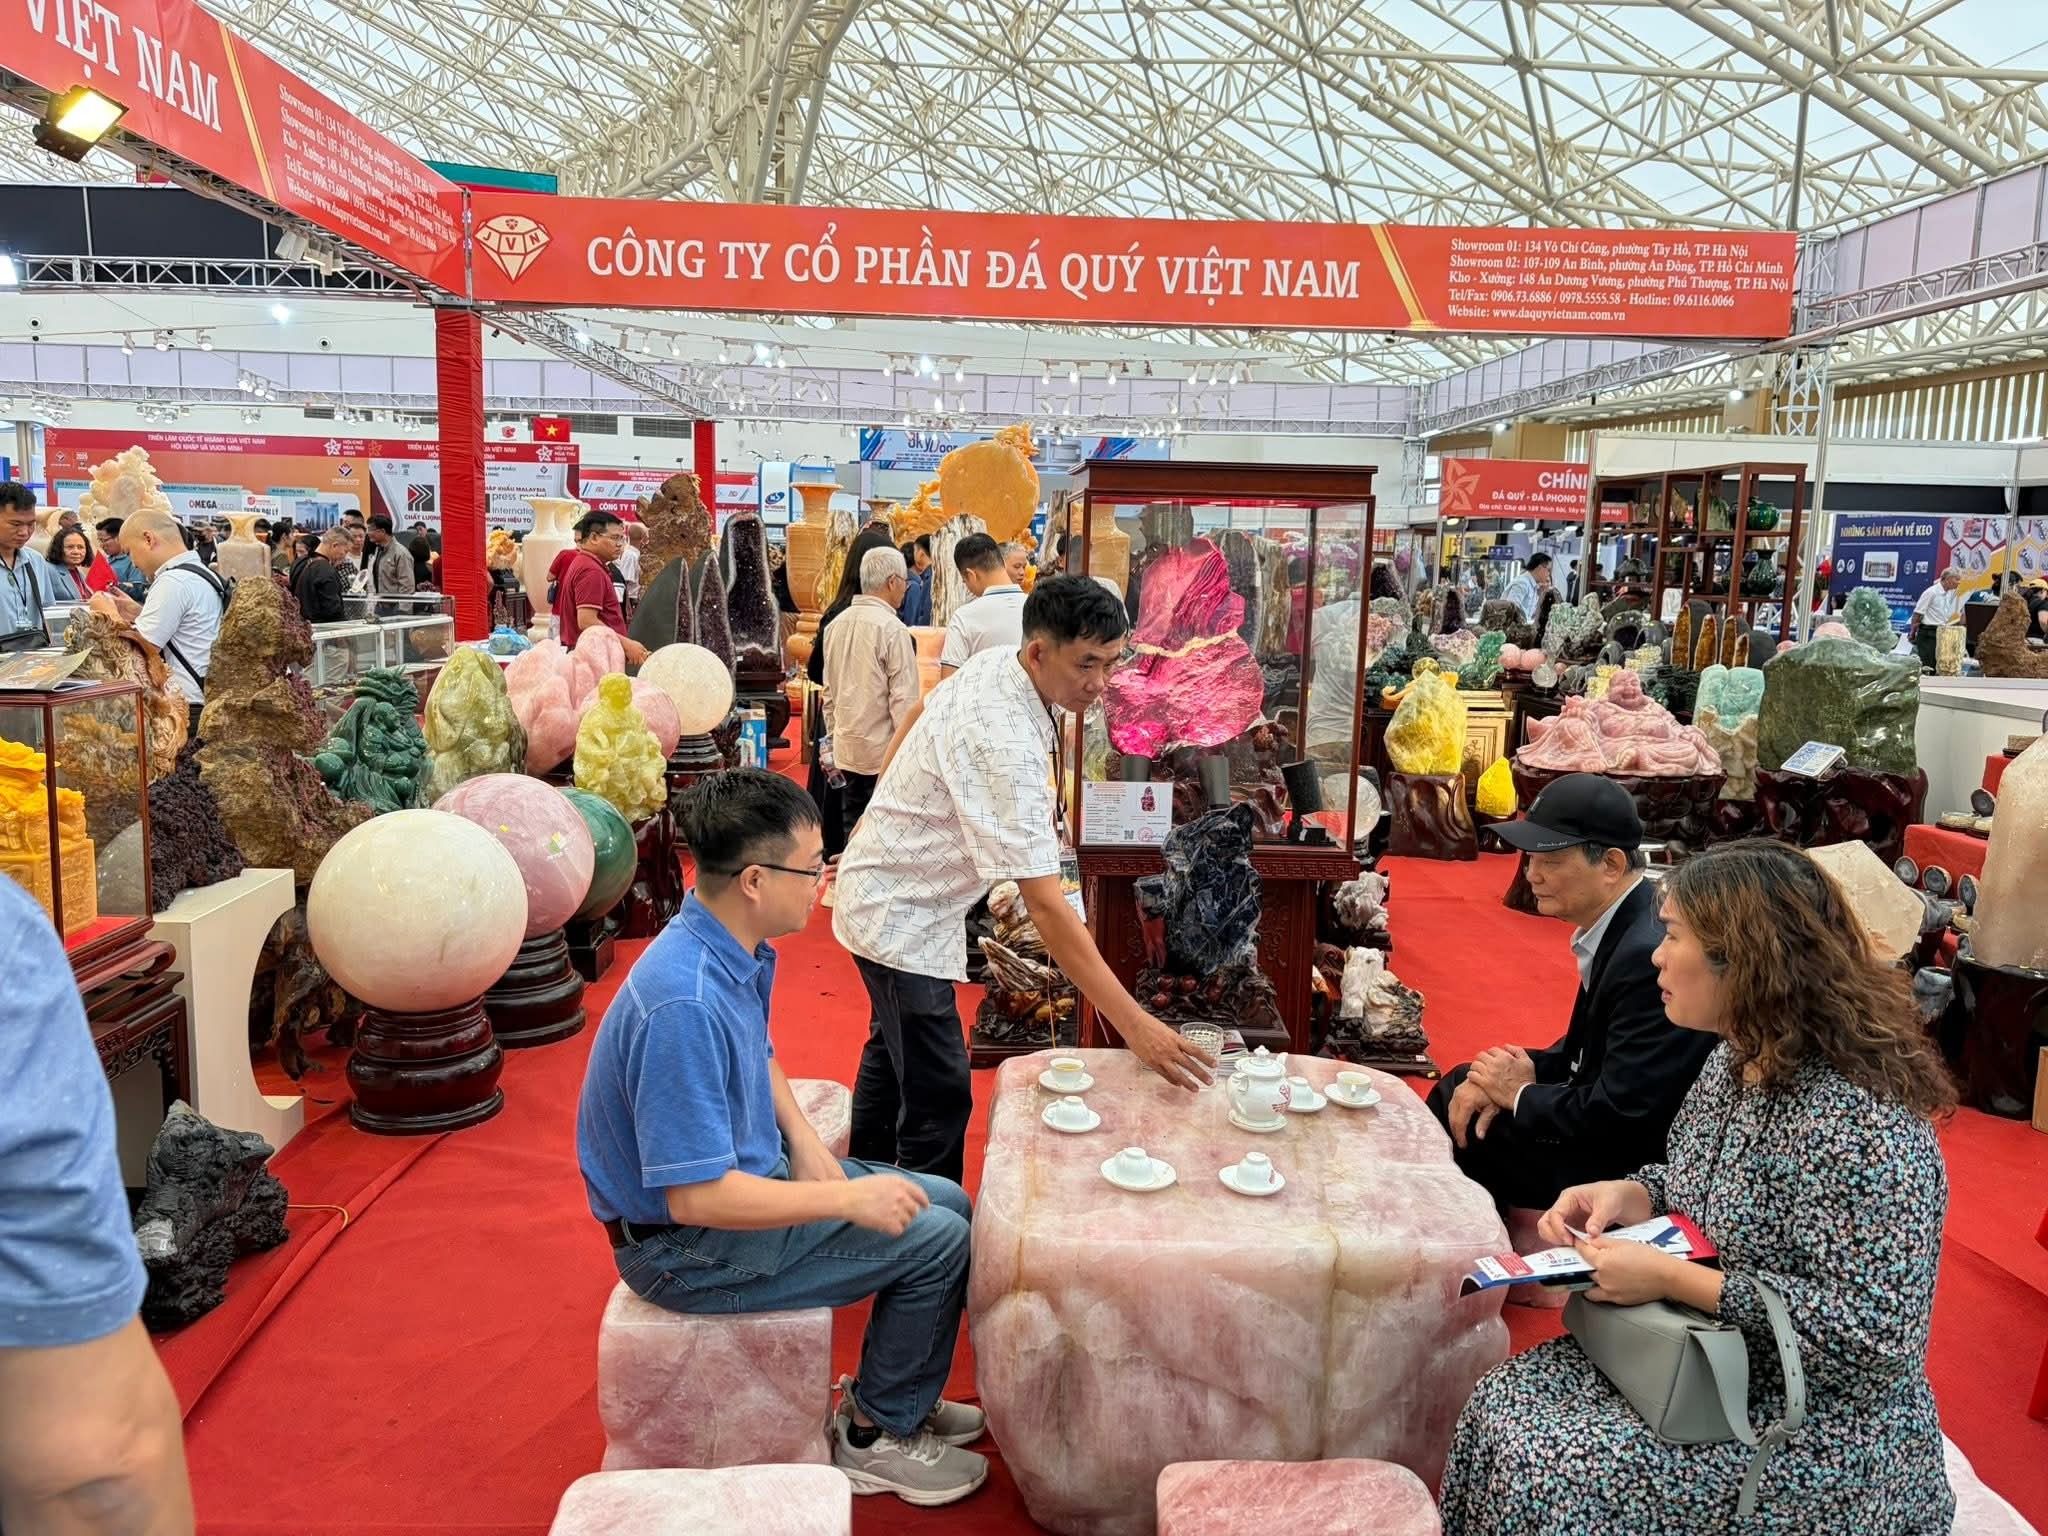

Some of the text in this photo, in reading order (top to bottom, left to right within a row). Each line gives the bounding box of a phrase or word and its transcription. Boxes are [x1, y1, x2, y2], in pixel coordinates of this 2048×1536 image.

[132, 26, 223, 133] NAM
[279, 83, 314, 119] Showroom
[1451, 238, 1505, 252] Showroom
[1506, 240, 1522, 252] 01:
[1525, 240, 1541, 253] 134
[1560, 240, 1578, 254] Chí
[1712, 244, 1728, 257] Hà
[1729, 244, 1749, 259] Nội
[587, 222, 1361, 306] CÔNG TY CỔ PHẦN ĐÁ QUÝ VIỆT NAM
[1450, 254, 1503, 268] Showroom
[1505, 256, 1521, 268] 02:
[1524, 257, 1560, 269] 107-109
[1562, 258, 1577, 269] An
[1648, 260, 1663, 272] An
[1735, 260, 1753, 273] Chí
[1755, 261, 1784, 274] Minh
[1448, 271, 1471, 283] Kho
[1518, 274, 1535, 285] 148
[1537, 274, 1552, 285] An
[1752, 278, 1768, 289] Hà
[1770, 278, 1789, 293] Nội
[1449, 288, 1489, 301] Tel/Fax:
[1490, 290, 1552, 303] 0906.73.6886
[1559, 292, 1621, 305] 0978.5555.58
[1629, 293, 1671, 306] Hotline:
[1673, 294, 1735, 307] 09.6116.0066
[1448, 305, 1626, 321] Website: www.daquyvietnam.com.vn
[1538, 469, 1587, 489] CHÍN
[188, 500, 217, 509] OMEGA
[1491, 490, 1505, 499] ĐÁ
[1506, 490, 1526, 501] QUÝ
[1531, 491, 1544, 502] ĐÁ
[1546, 494, 1576, 504] PHONG
[1915, 524, 1933, 537] KEO
